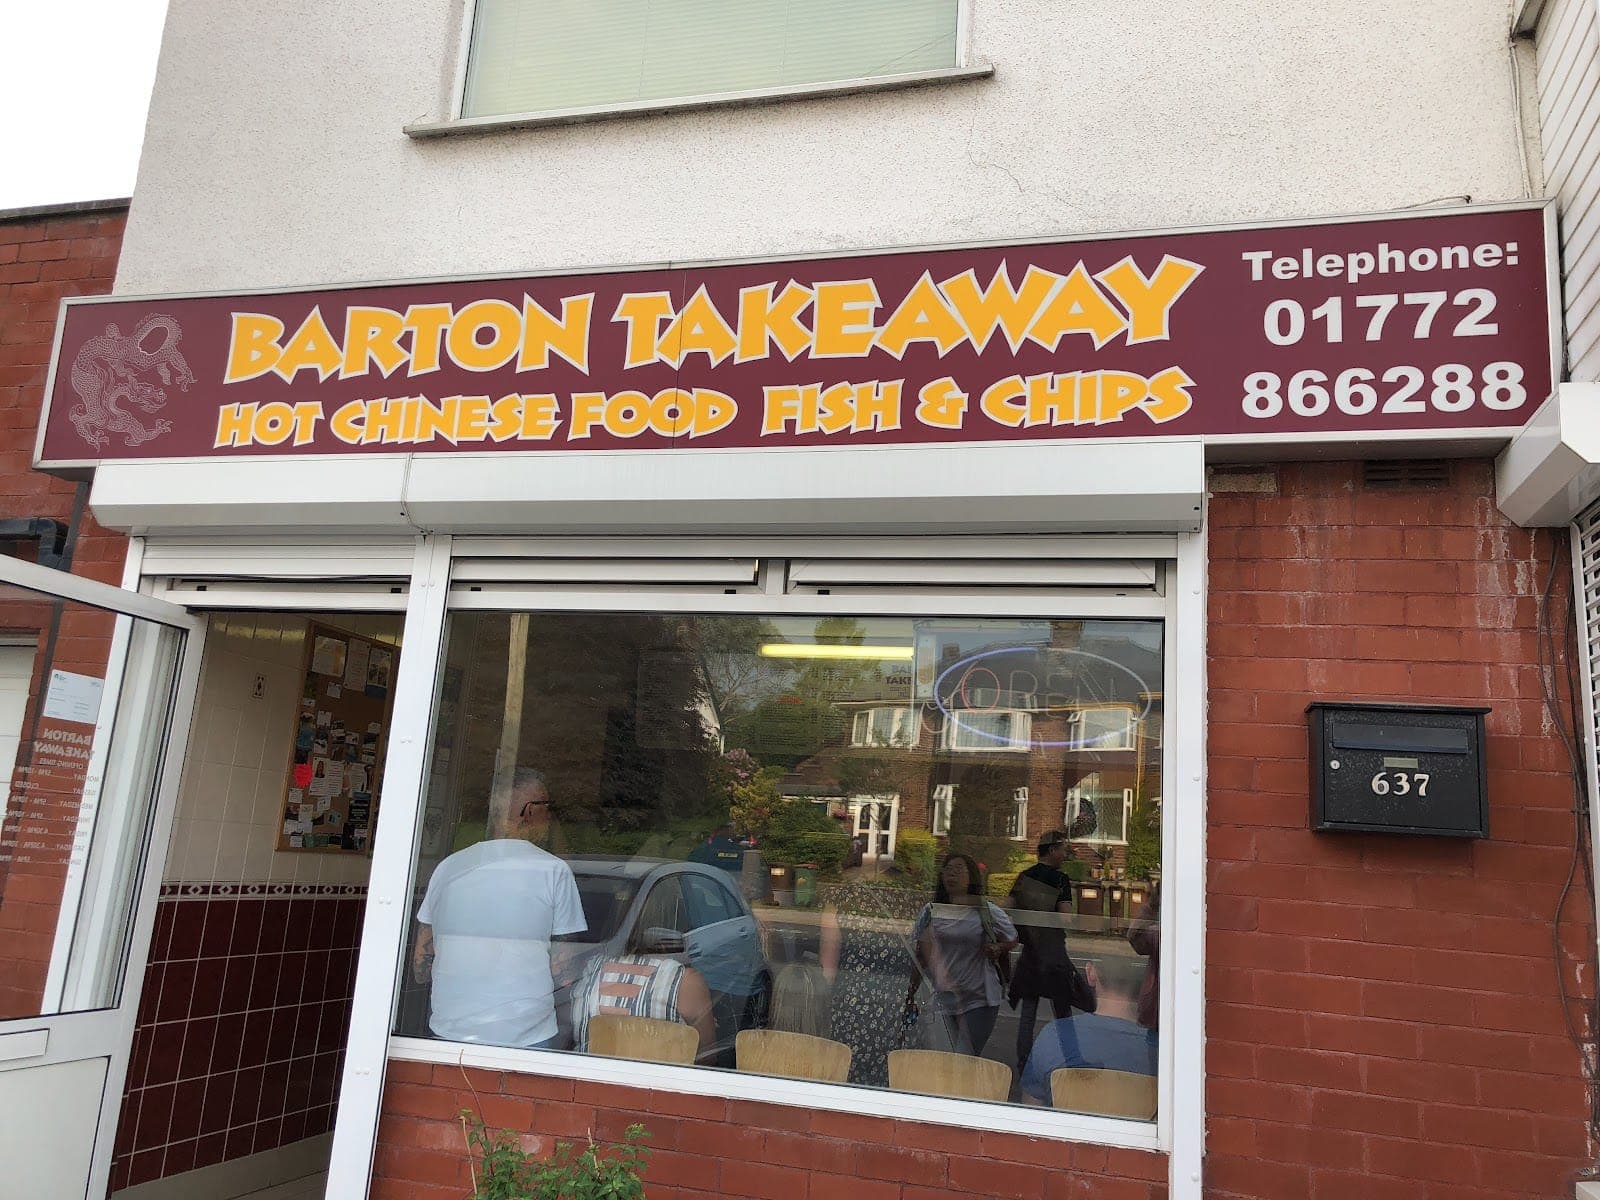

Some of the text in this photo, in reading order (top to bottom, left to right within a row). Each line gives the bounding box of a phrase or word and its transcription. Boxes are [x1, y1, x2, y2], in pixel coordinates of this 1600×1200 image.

[1242, 241, 1520, 284] Telephone:
[223, 253, 1206, 385] BARTON TAKEAWAY
[1263, 288, 1499, 347] 01772
[213, 365, 1198, 449] HOT CHINESE FOOD FISH & CHIPS
[1241, 360, 1528, 419] 866288
[962, 664, 1115, 717] OPEN
[1371, 771, 1430, 797] 637
